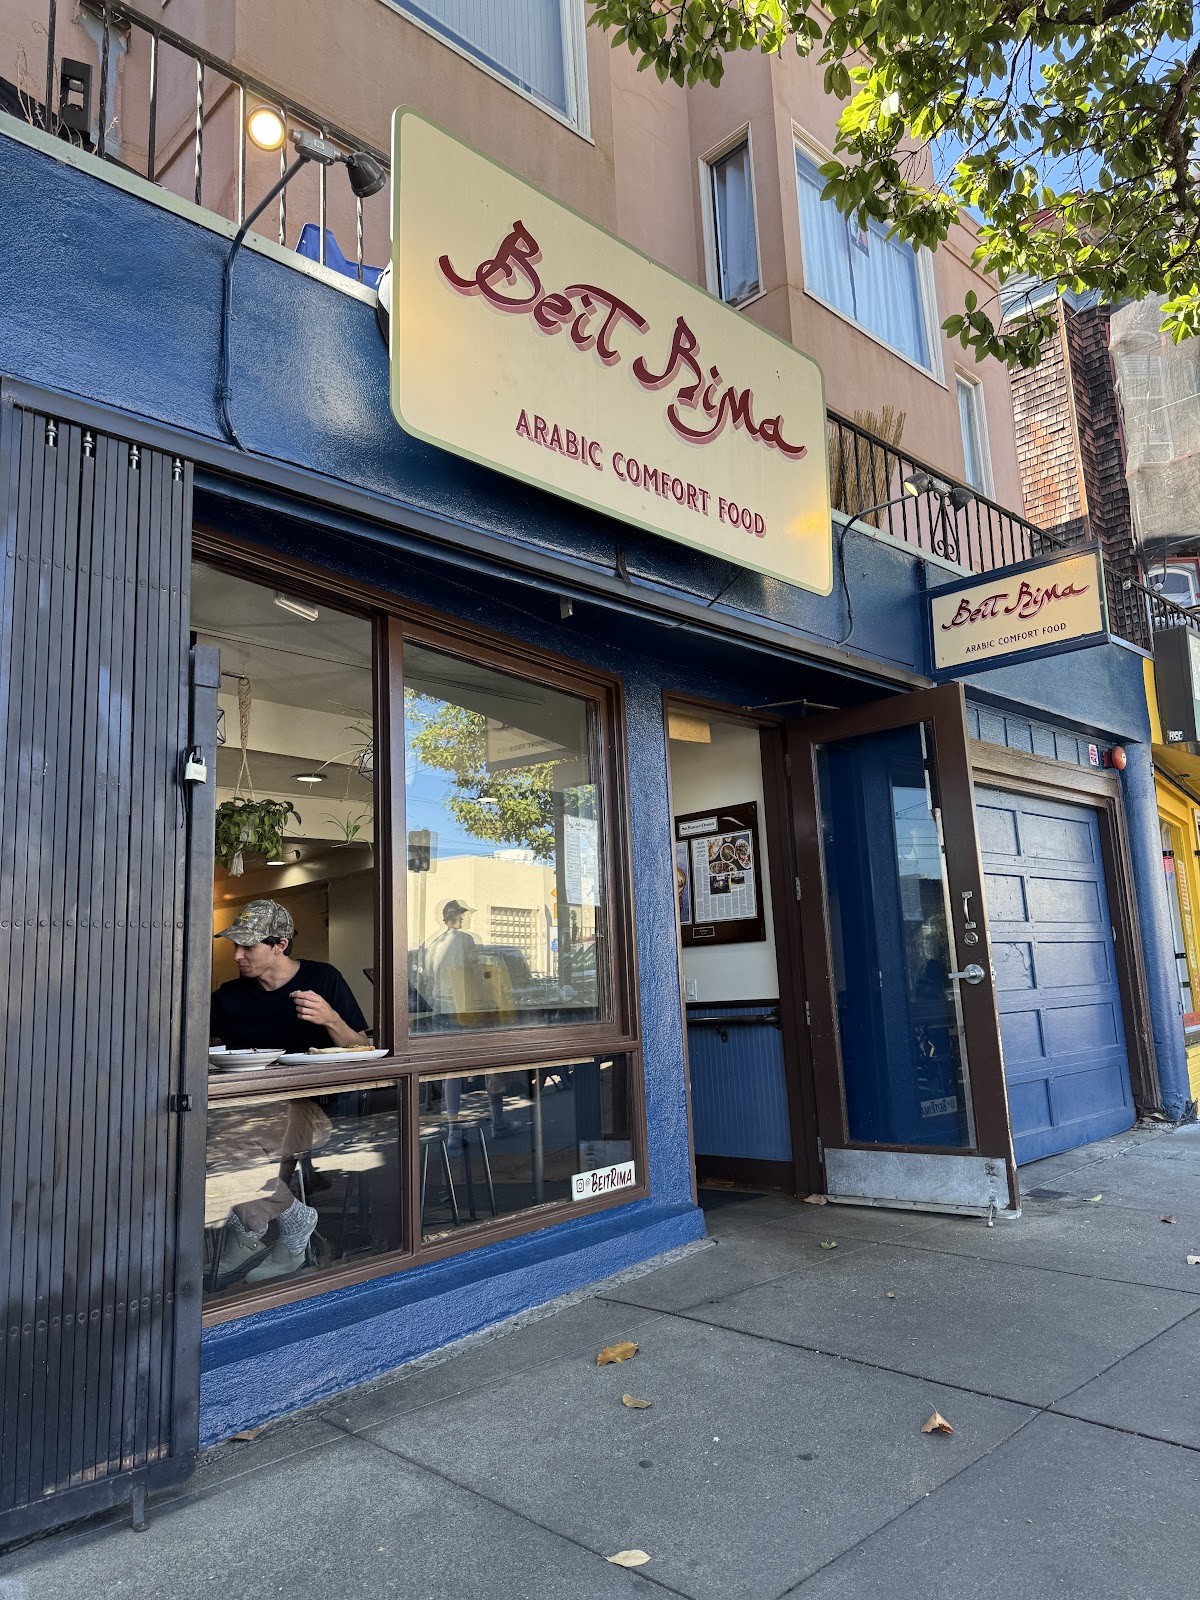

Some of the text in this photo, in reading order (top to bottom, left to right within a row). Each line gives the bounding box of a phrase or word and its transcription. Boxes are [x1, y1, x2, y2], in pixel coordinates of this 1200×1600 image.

[515, 409, 767, 538] ARABIC COMFORT FOOD
[965, 622, 1067, 654] ARABIC COMFORT FOOD
